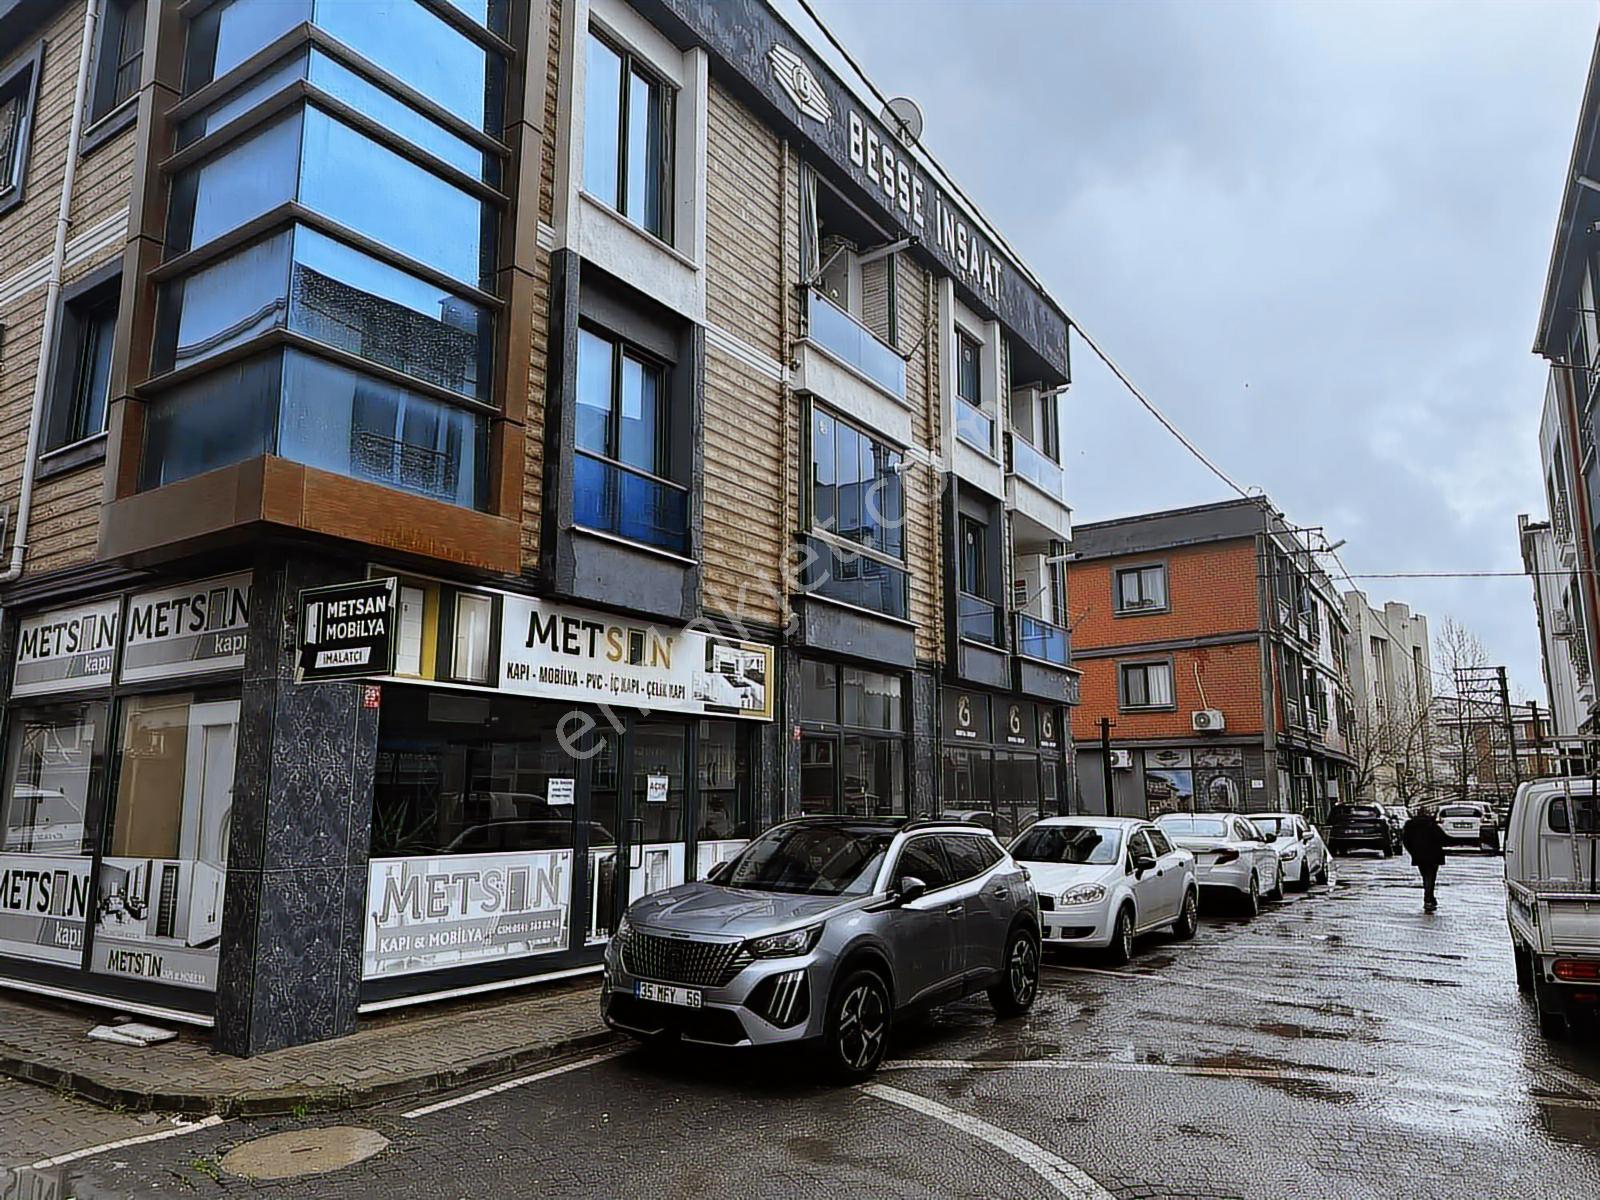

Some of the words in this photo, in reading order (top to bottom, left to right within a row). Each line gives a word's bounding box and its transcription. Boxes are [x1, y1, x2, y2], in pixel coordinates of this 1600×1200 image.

[849, 110, 924, 228] BESSE
[327, 595, 386, 619] METSAN
[506, 661, 530, 681] KAPI
[538, 664, 578, 687] MOBİLYA
[586, 672, 604, 690] PVC
[380, 935, 411, 954] KAPI
[414, 936, 426, 949] &
[428, 926, 482, 948] MOBİLYA
[641, 982, 653, 999] 35
